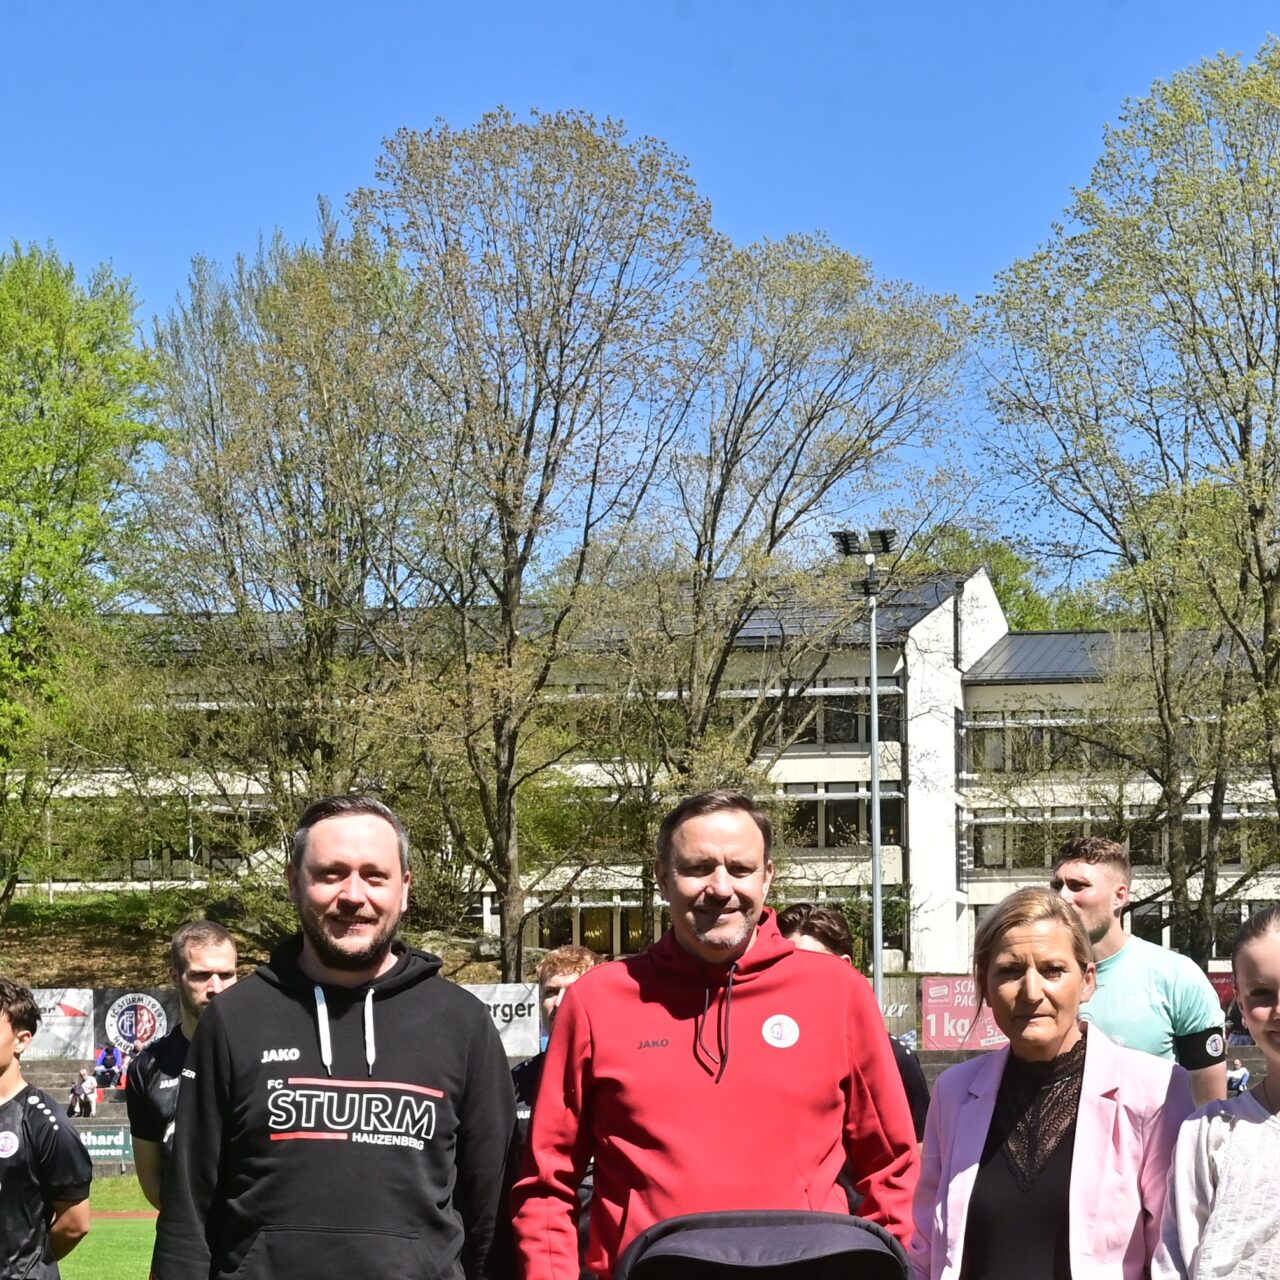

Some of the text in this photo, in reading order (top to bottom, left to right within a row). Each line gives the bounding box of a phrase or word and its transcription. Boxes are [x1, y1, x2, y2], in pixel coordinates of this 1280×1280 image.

[118, 996, 144, 1010] STURM
[147, 1001, 163, 1018] 1919
[489, 1001, 535, 1023] rger
[926, 1012, 971, 1042] 1 kg
[638, 1039, 669, 1050] JAKO
[261, 1048, 300, 1063] JAKO
[267, 1080, 284, 1090] FC
[268, 1090, 436, 1140] STURM
[352, 1132, 424, 1150] HAUZENBERG
